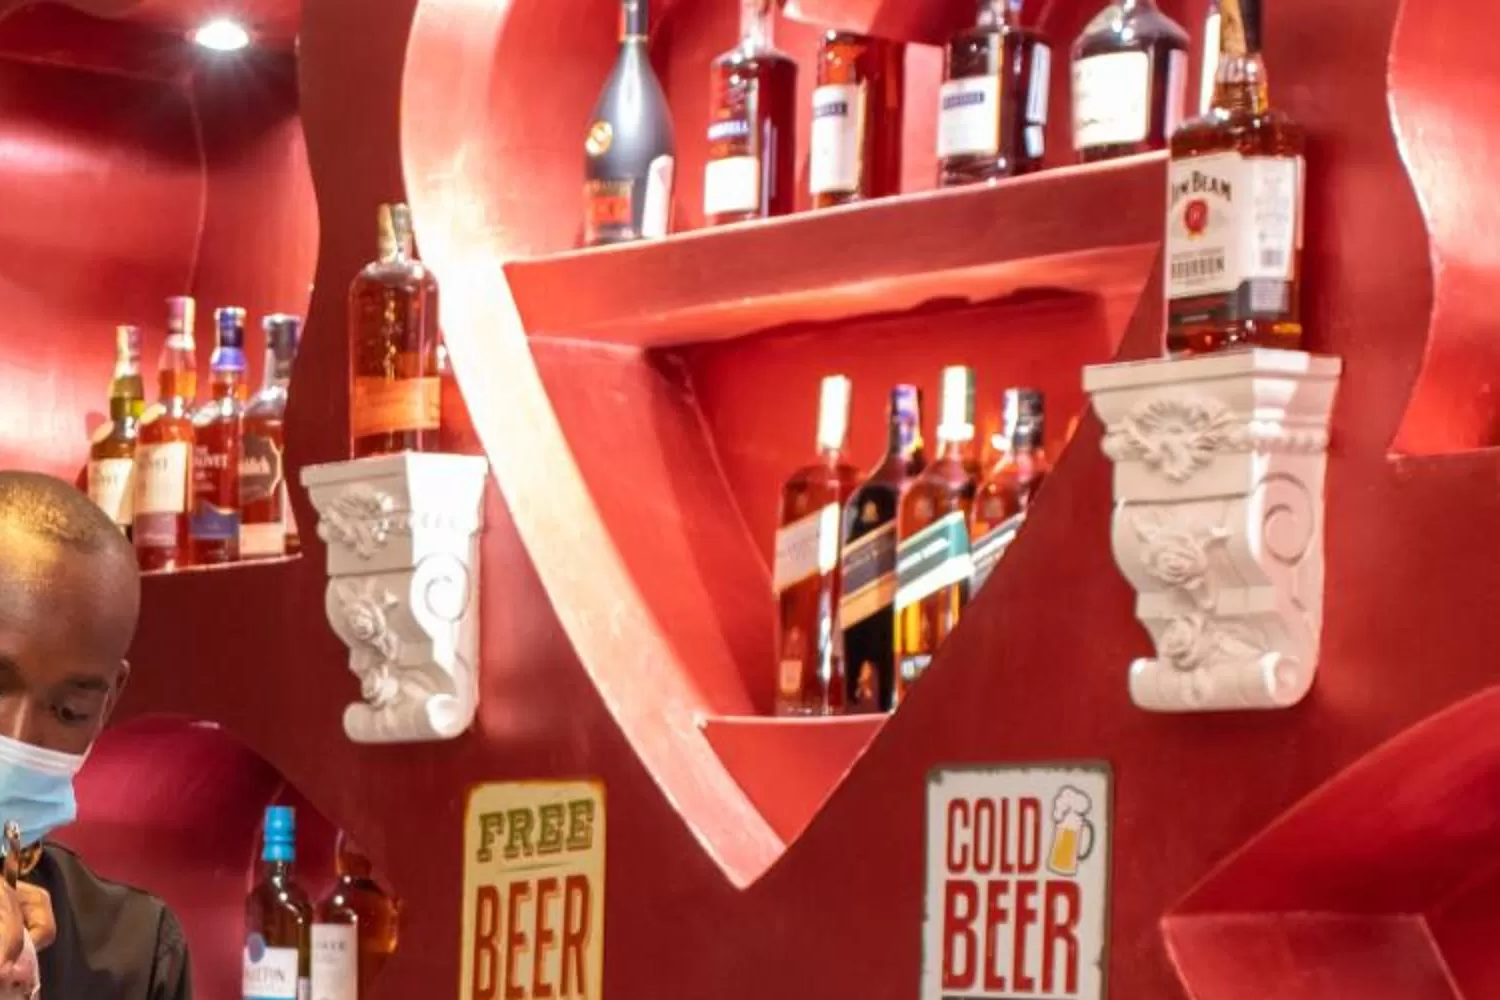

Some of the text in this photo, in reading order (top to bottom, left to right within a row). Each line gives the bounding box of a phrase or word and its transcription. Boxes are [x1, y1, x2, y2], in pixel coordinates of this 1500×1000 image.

[1192, 171, 1232, 201] BEAM
[476, 798, 595, 863] FREE
[946, 797, 1042, 874] COLD
[942, 879, 1081, 993] BEER
